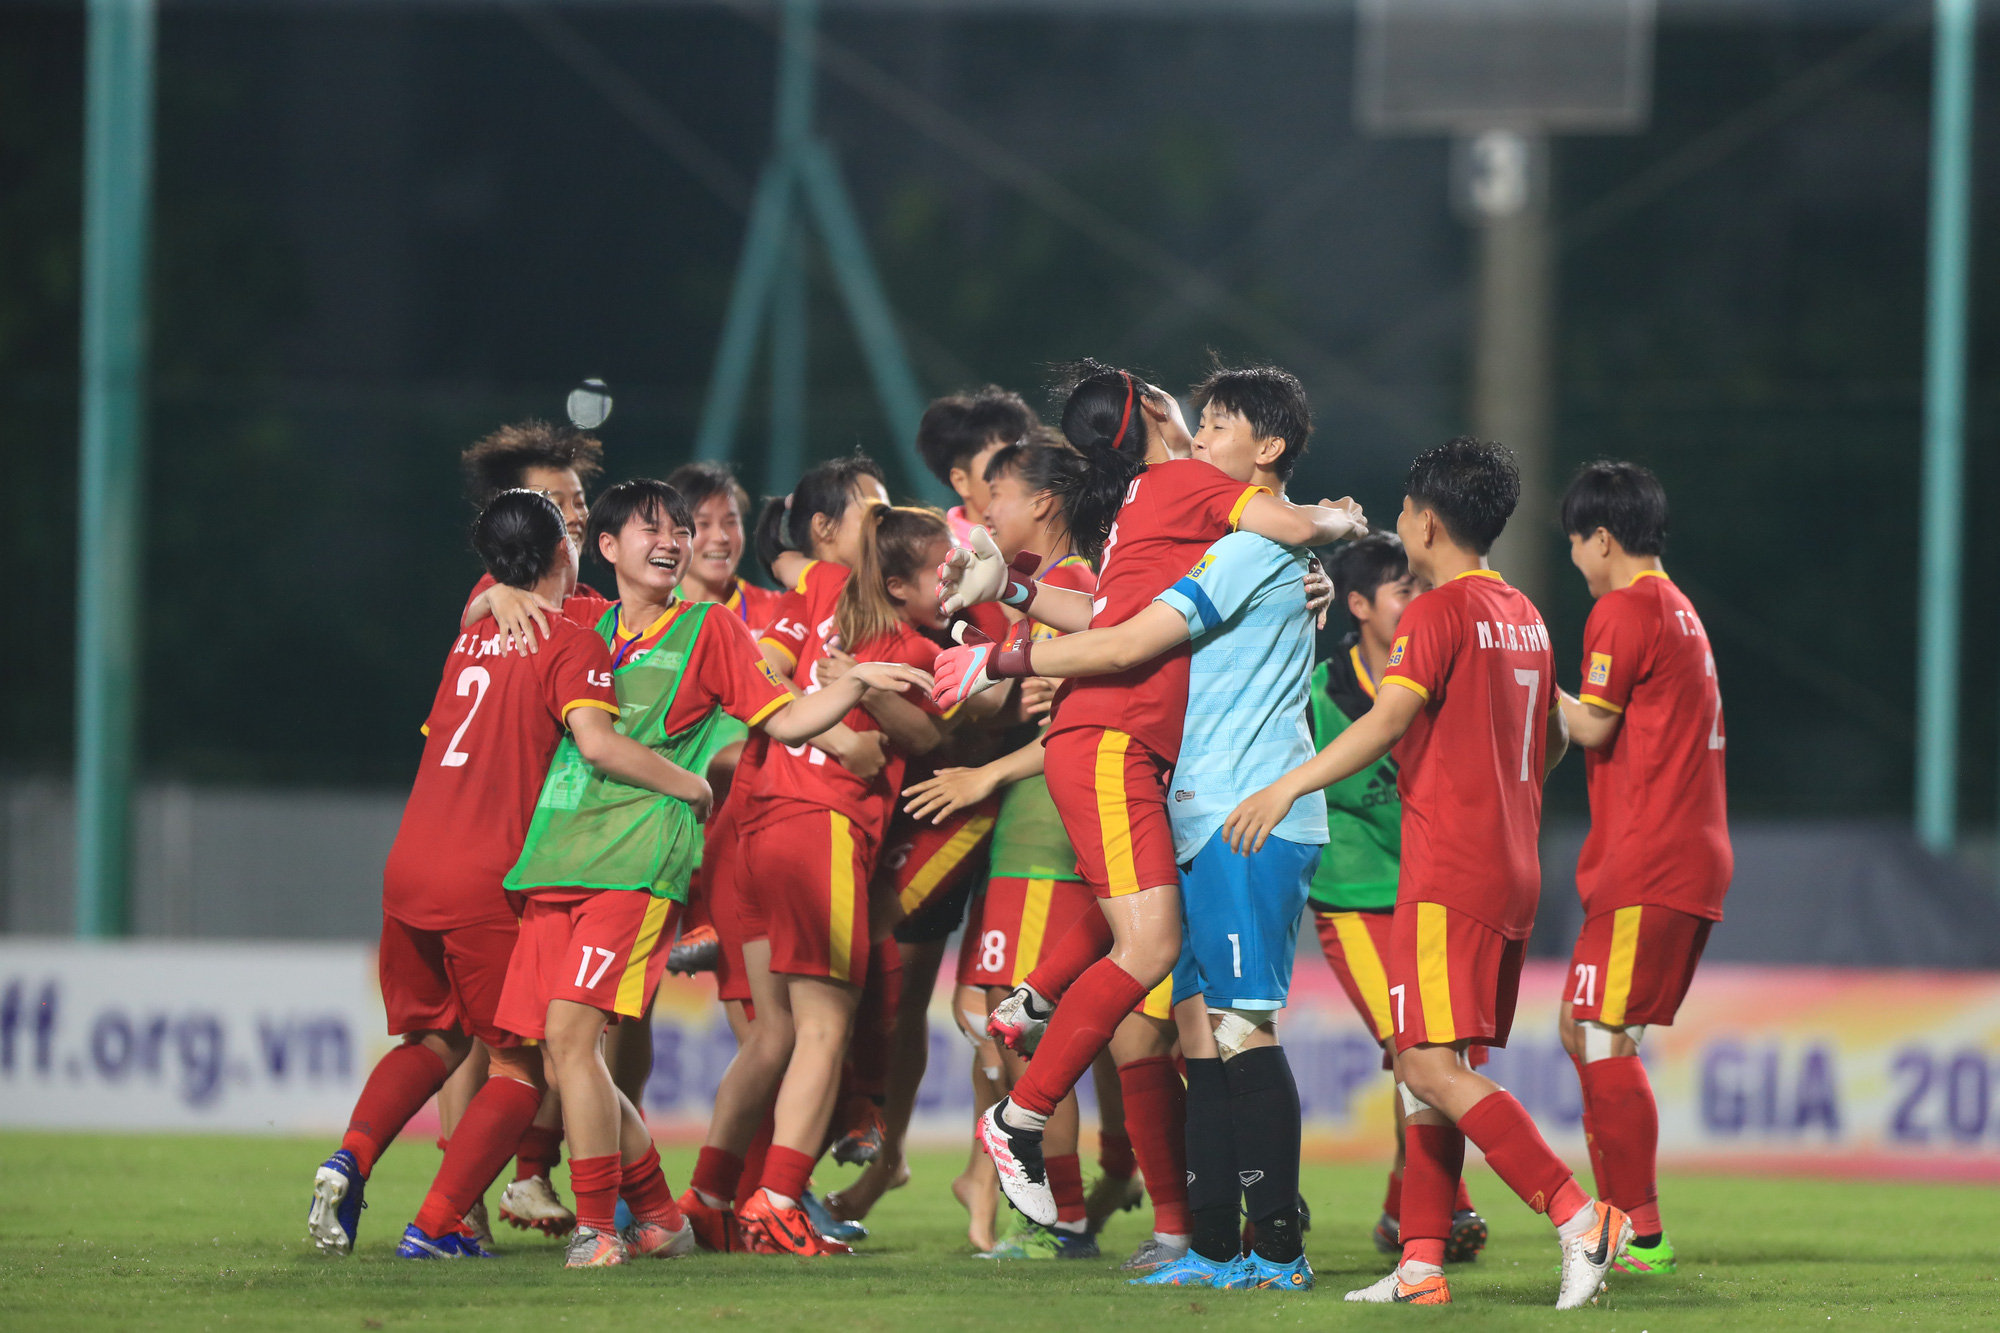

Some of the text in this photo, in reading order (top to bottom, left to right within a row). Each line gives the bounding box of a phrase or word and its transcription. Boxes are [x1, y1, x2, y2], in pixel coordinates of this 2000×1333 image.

[440, 665, 491, 767] 2
[1514, 668, 1540, 782] 7
[574, 945, 616, 990] 17
[1227, 933, 1242, 978] 1
[1389, 984, 1406, 1033] 7
[1572, 963, 1598, 1007] 21
[1699, 1043, 1841, 1135] GIA
[1891, 1047, 2000, 1142] 20
